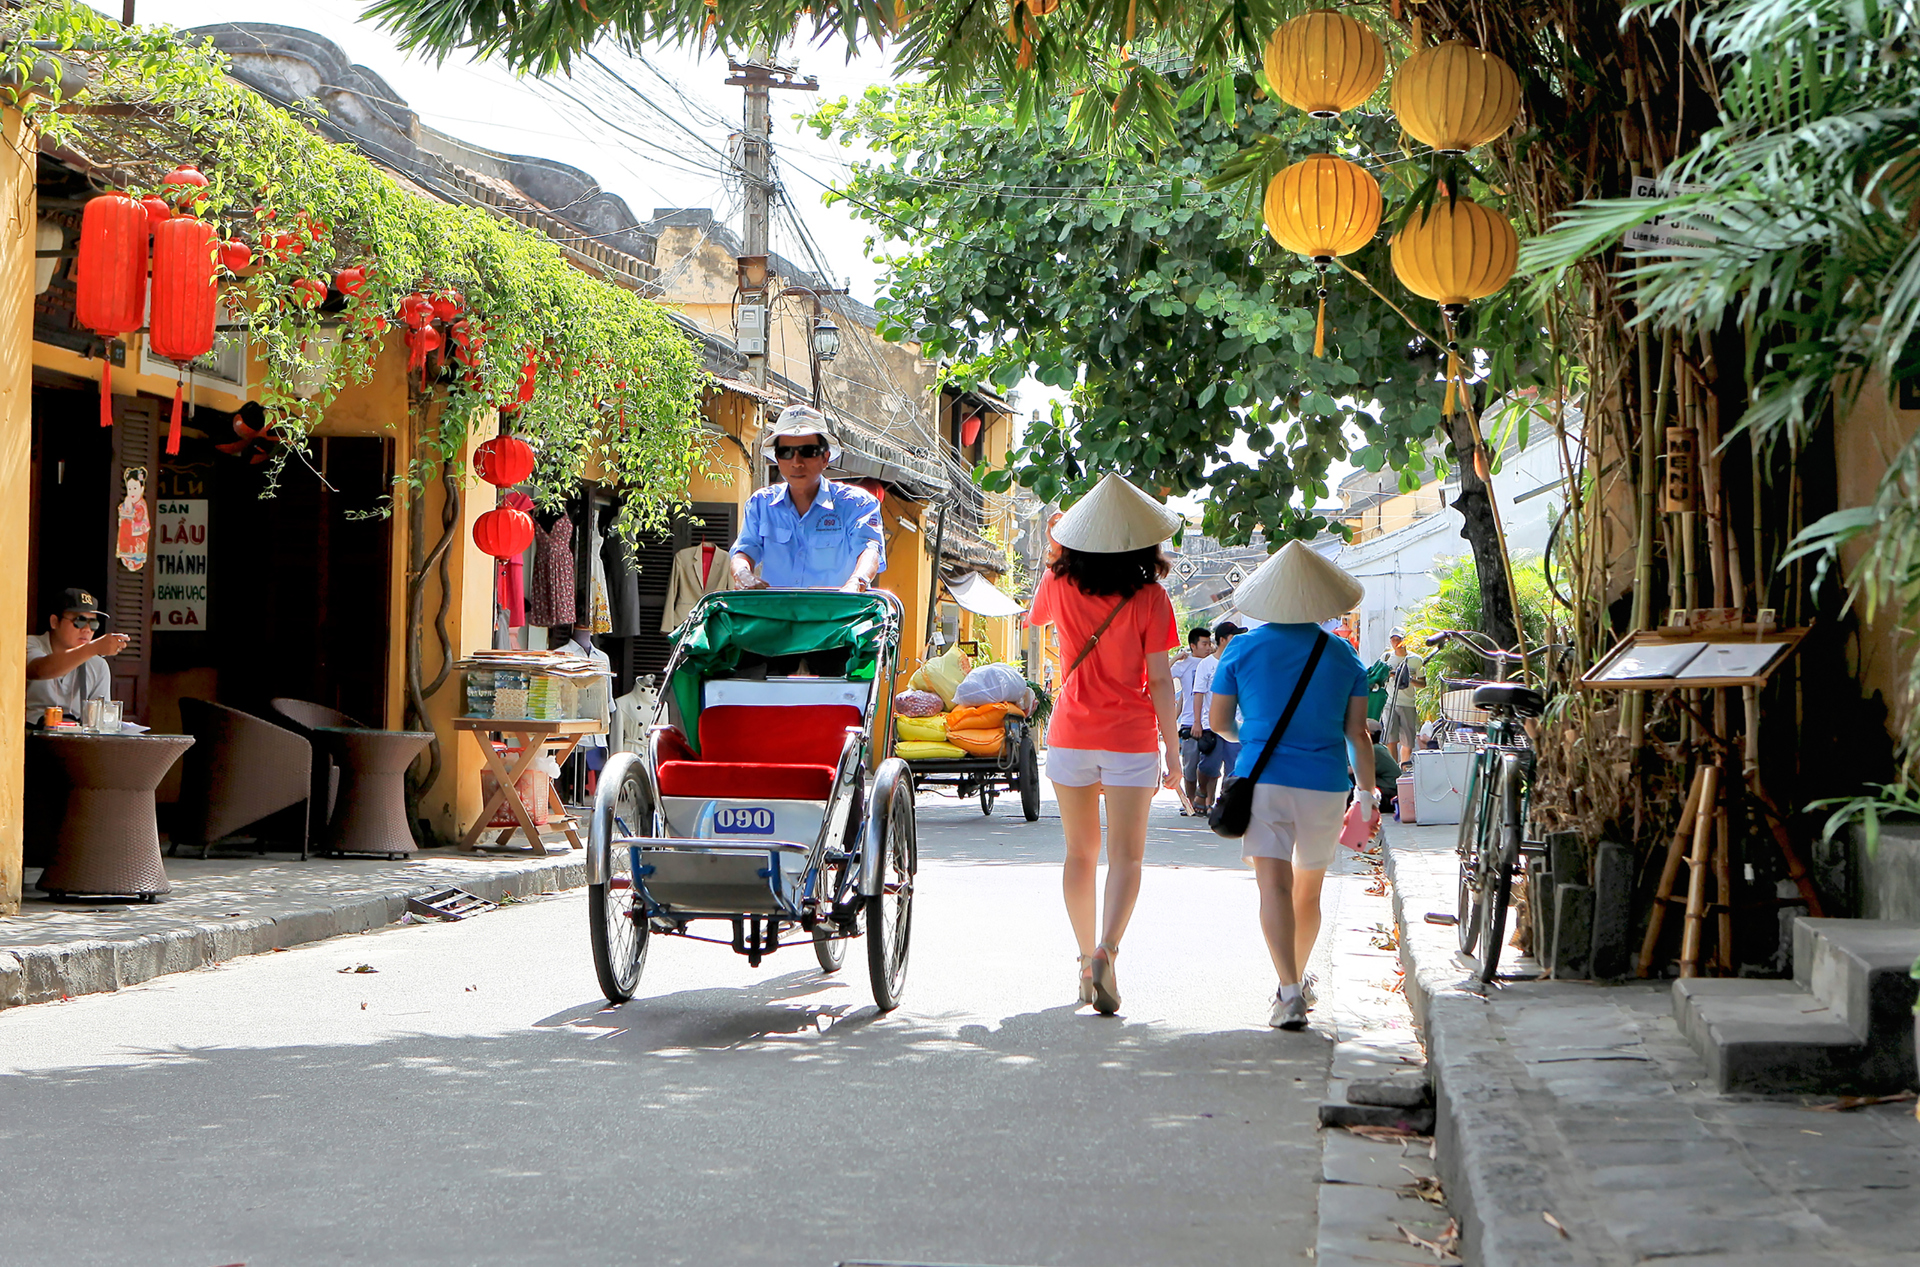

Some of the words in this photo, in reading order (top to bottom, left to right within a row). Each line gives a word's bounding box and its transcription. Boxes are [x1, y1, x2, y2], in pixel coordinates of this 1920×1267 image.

[1669, 441, 1691, 502] MENU
[168, 607, 199, 625] GÀ
[717, 809, 771, 828] 090
